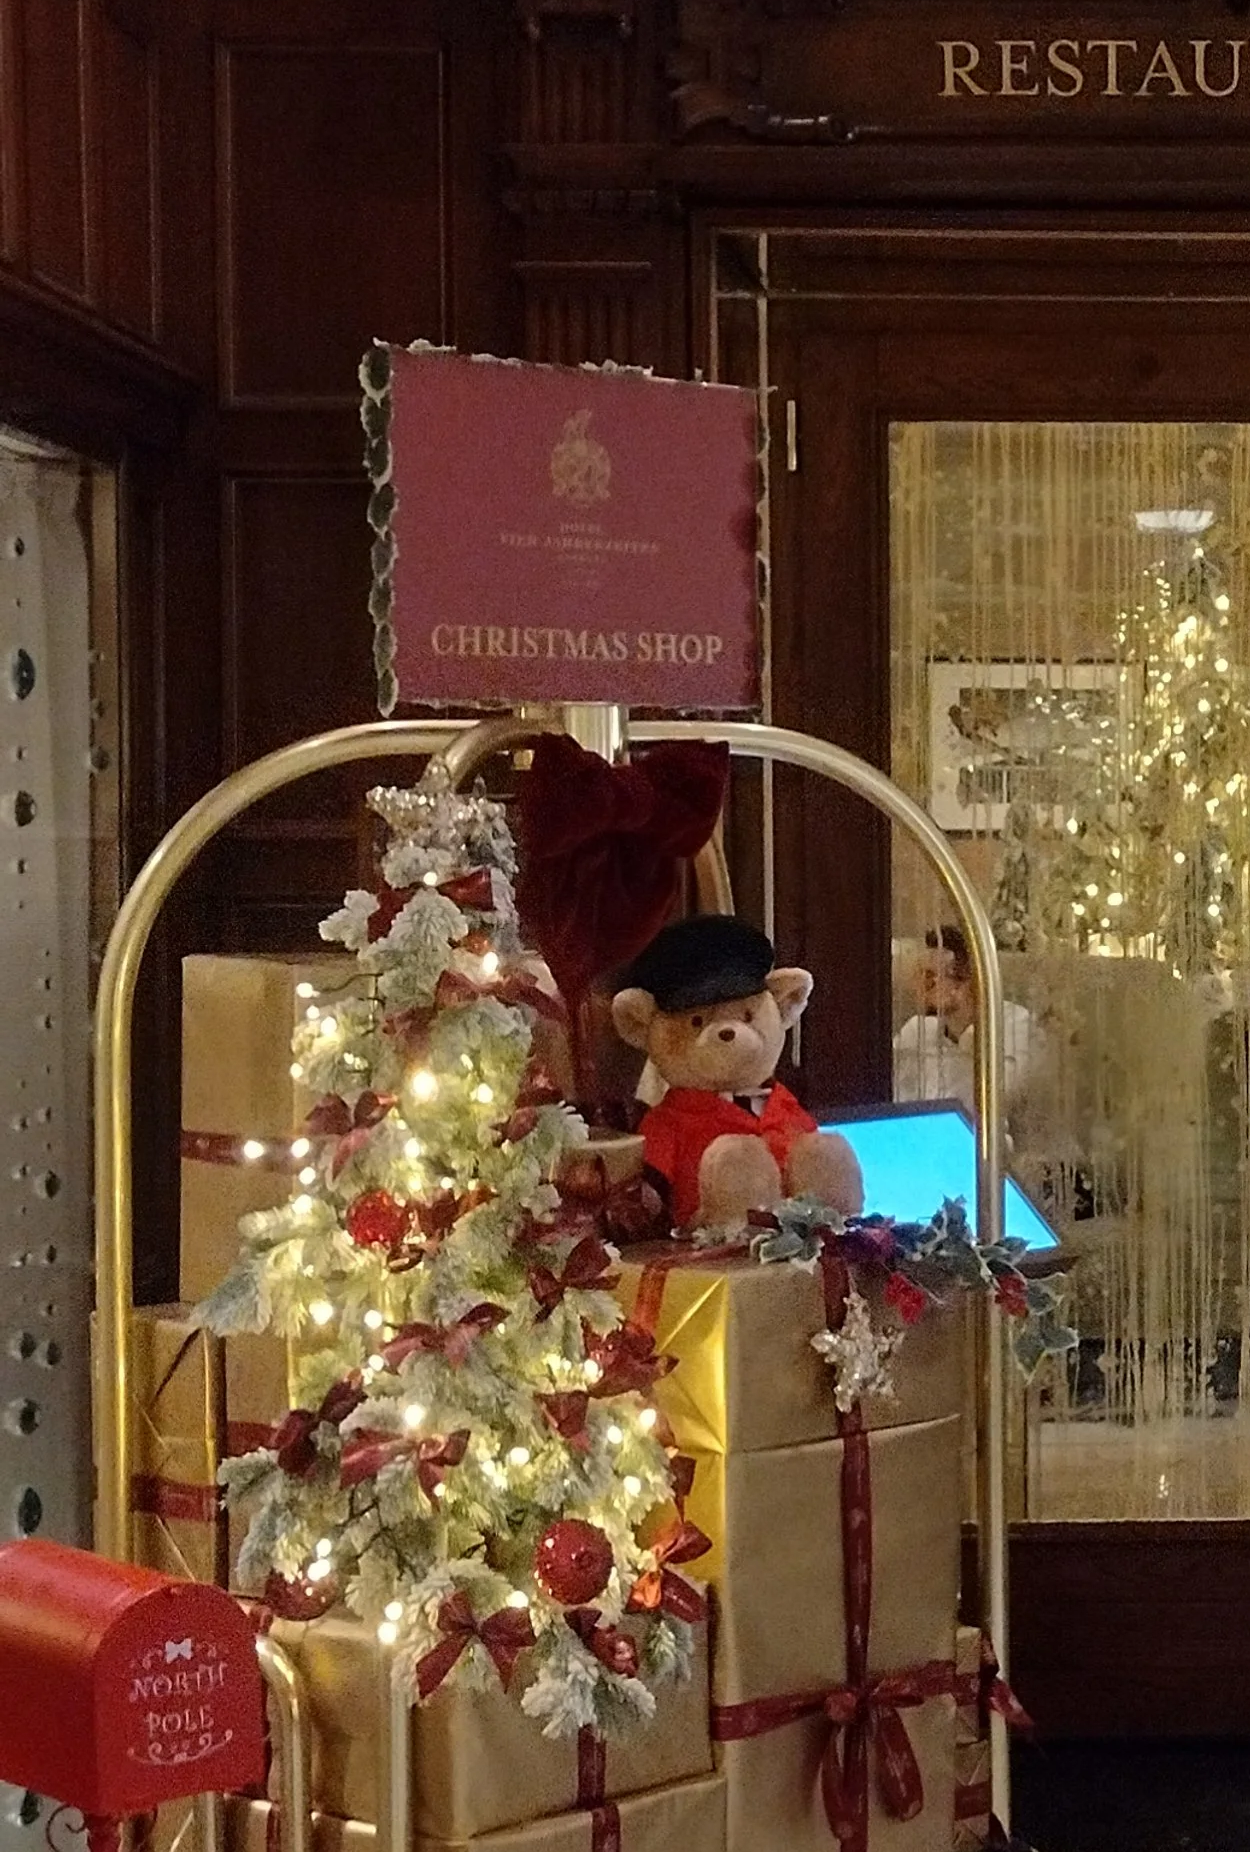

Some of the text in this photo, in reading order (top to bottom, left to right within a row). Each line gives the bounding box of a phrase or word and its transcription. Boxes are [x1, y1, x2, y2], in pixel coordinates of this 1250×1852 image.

[430, 623, 724, 664] CHRISTMAS SHOP
[129, 1662, 228, 1703] NORTH
[145, 1704, 214, 1738] POLE
